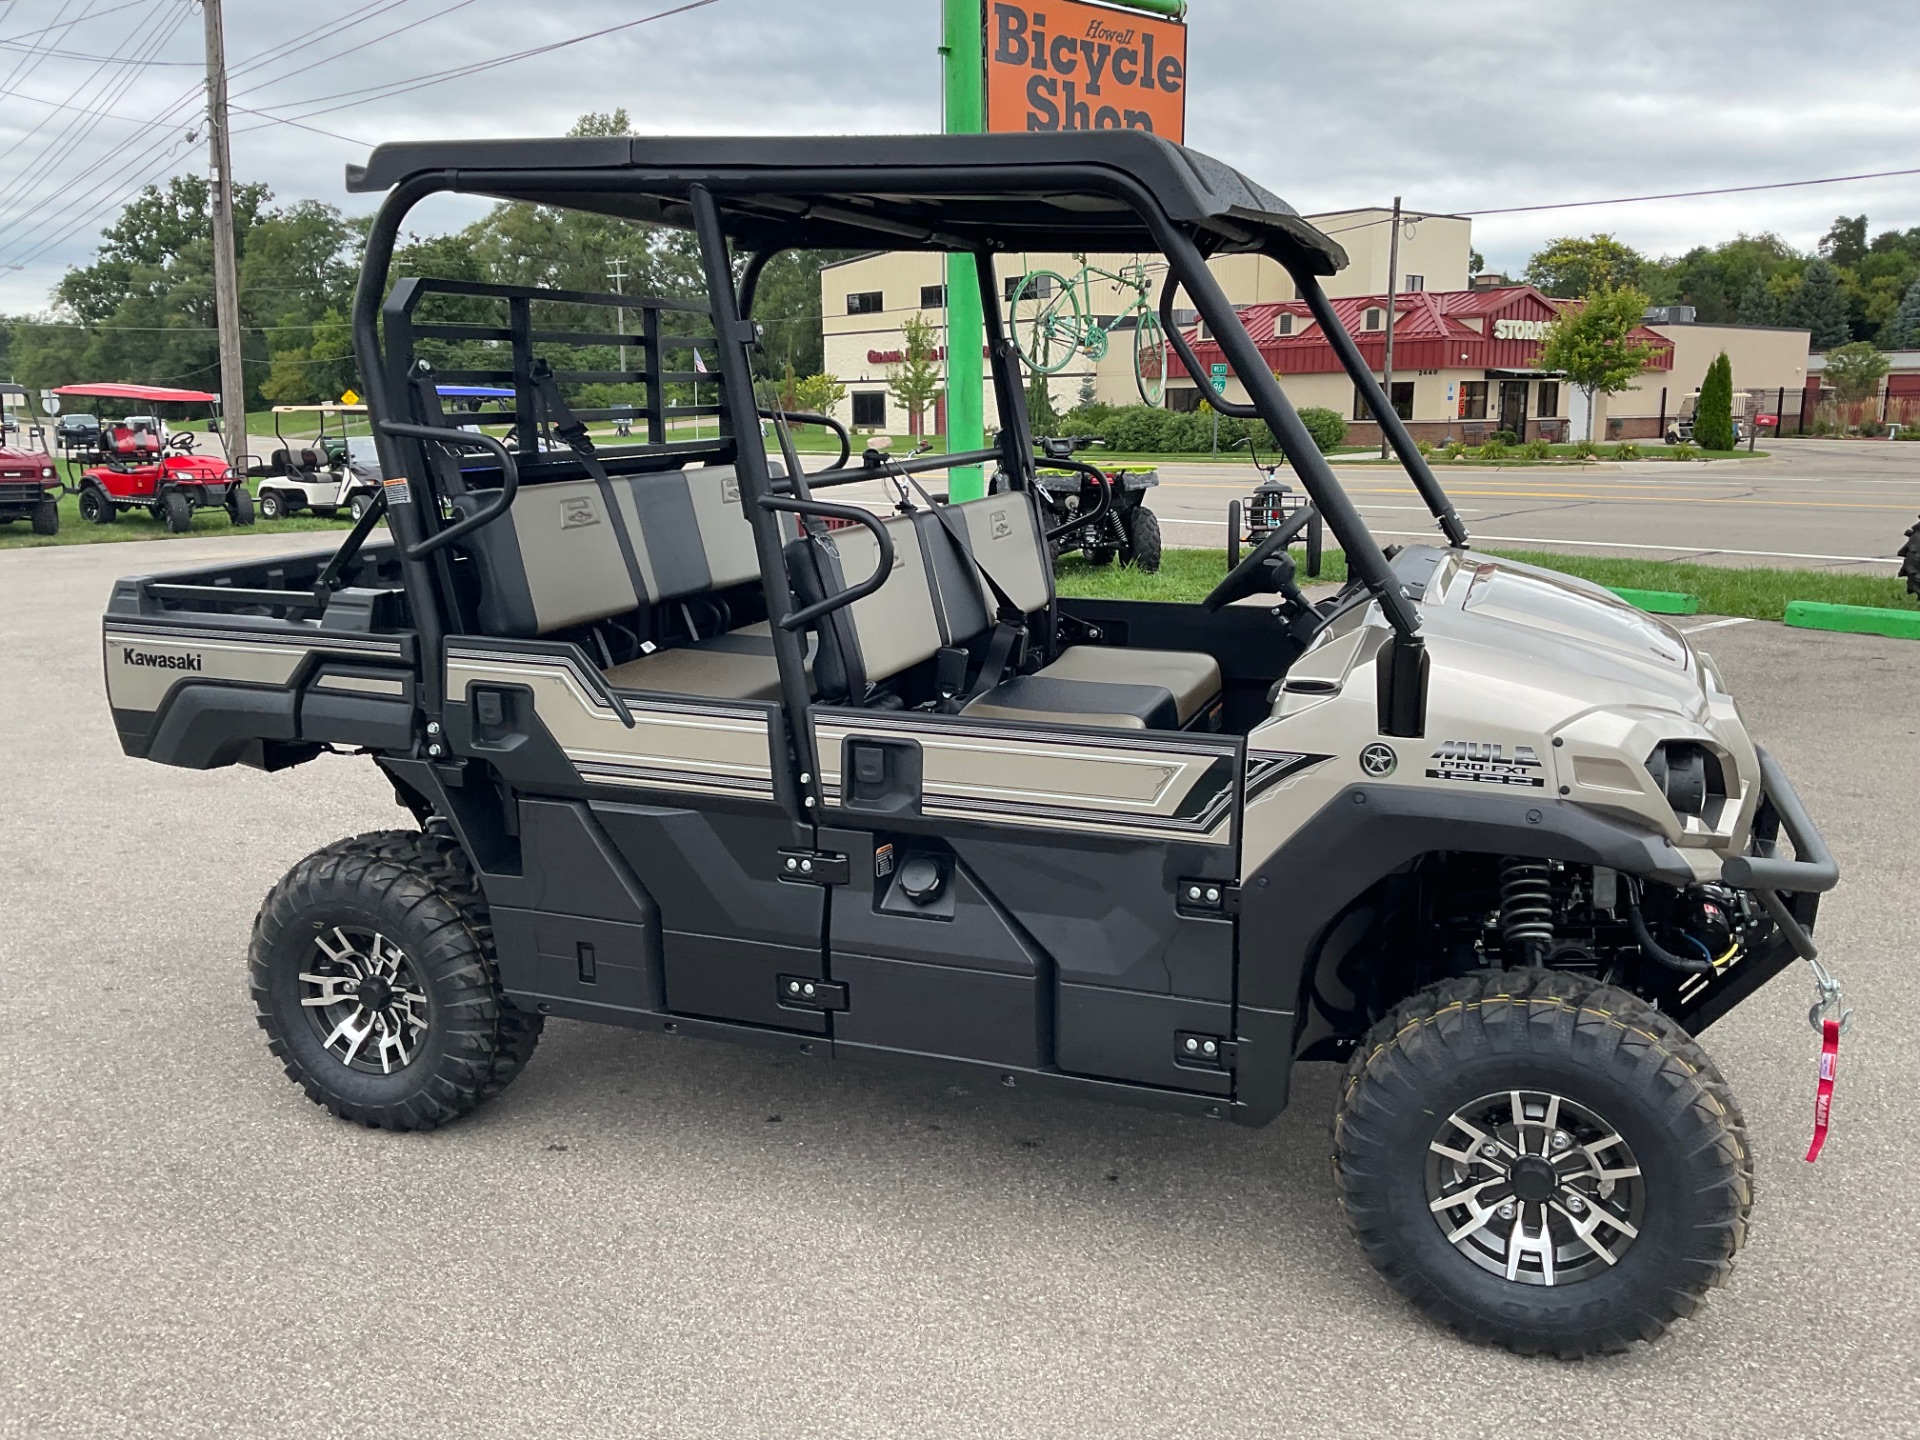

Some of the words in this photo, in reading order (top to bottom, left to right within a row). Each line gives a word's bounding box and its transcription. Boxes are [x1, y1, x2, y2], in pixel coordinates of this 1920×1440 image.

[1085, 19, 1135, 44] Howell
[994, 2, 1182, 95] Bicycle
[1213, 383, 1223, 392] 96
[123, 647, 202, 671] Kawasaki
[1430, 740, 1543, 767] MULE
